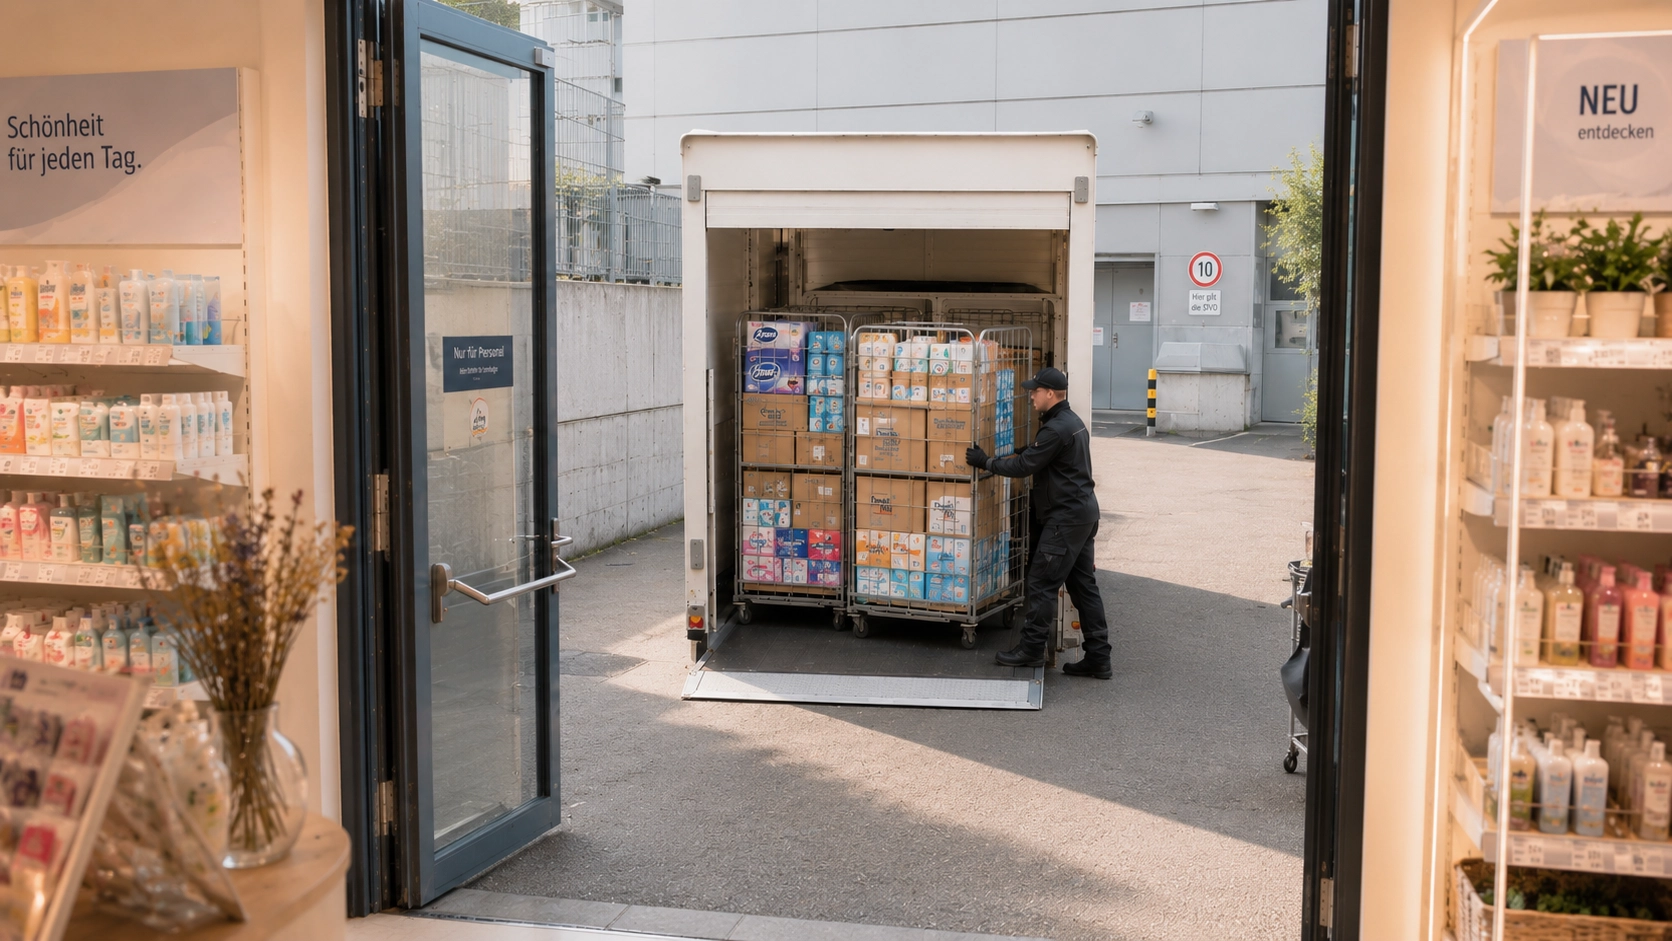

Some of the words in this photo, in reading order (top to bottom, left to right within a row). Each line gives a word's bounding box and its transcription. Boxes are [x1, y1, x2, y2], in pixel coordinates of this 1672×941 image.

[1579, 84, 1638, 115] NEU
[7, 113, 104, 138] Schönheit
[1578, 124, 1654, 140] entdecken
[8, 147, 35, 171] für
[41, 146, 94, 176] jeden
[101, 145, 142, 175] Tag.
[1198, 261, 1213, 277] 10
[453, 346, 466, 359] Nur
[467, 346, 477, 359] für
[478, 345, 504, 358] Personal
